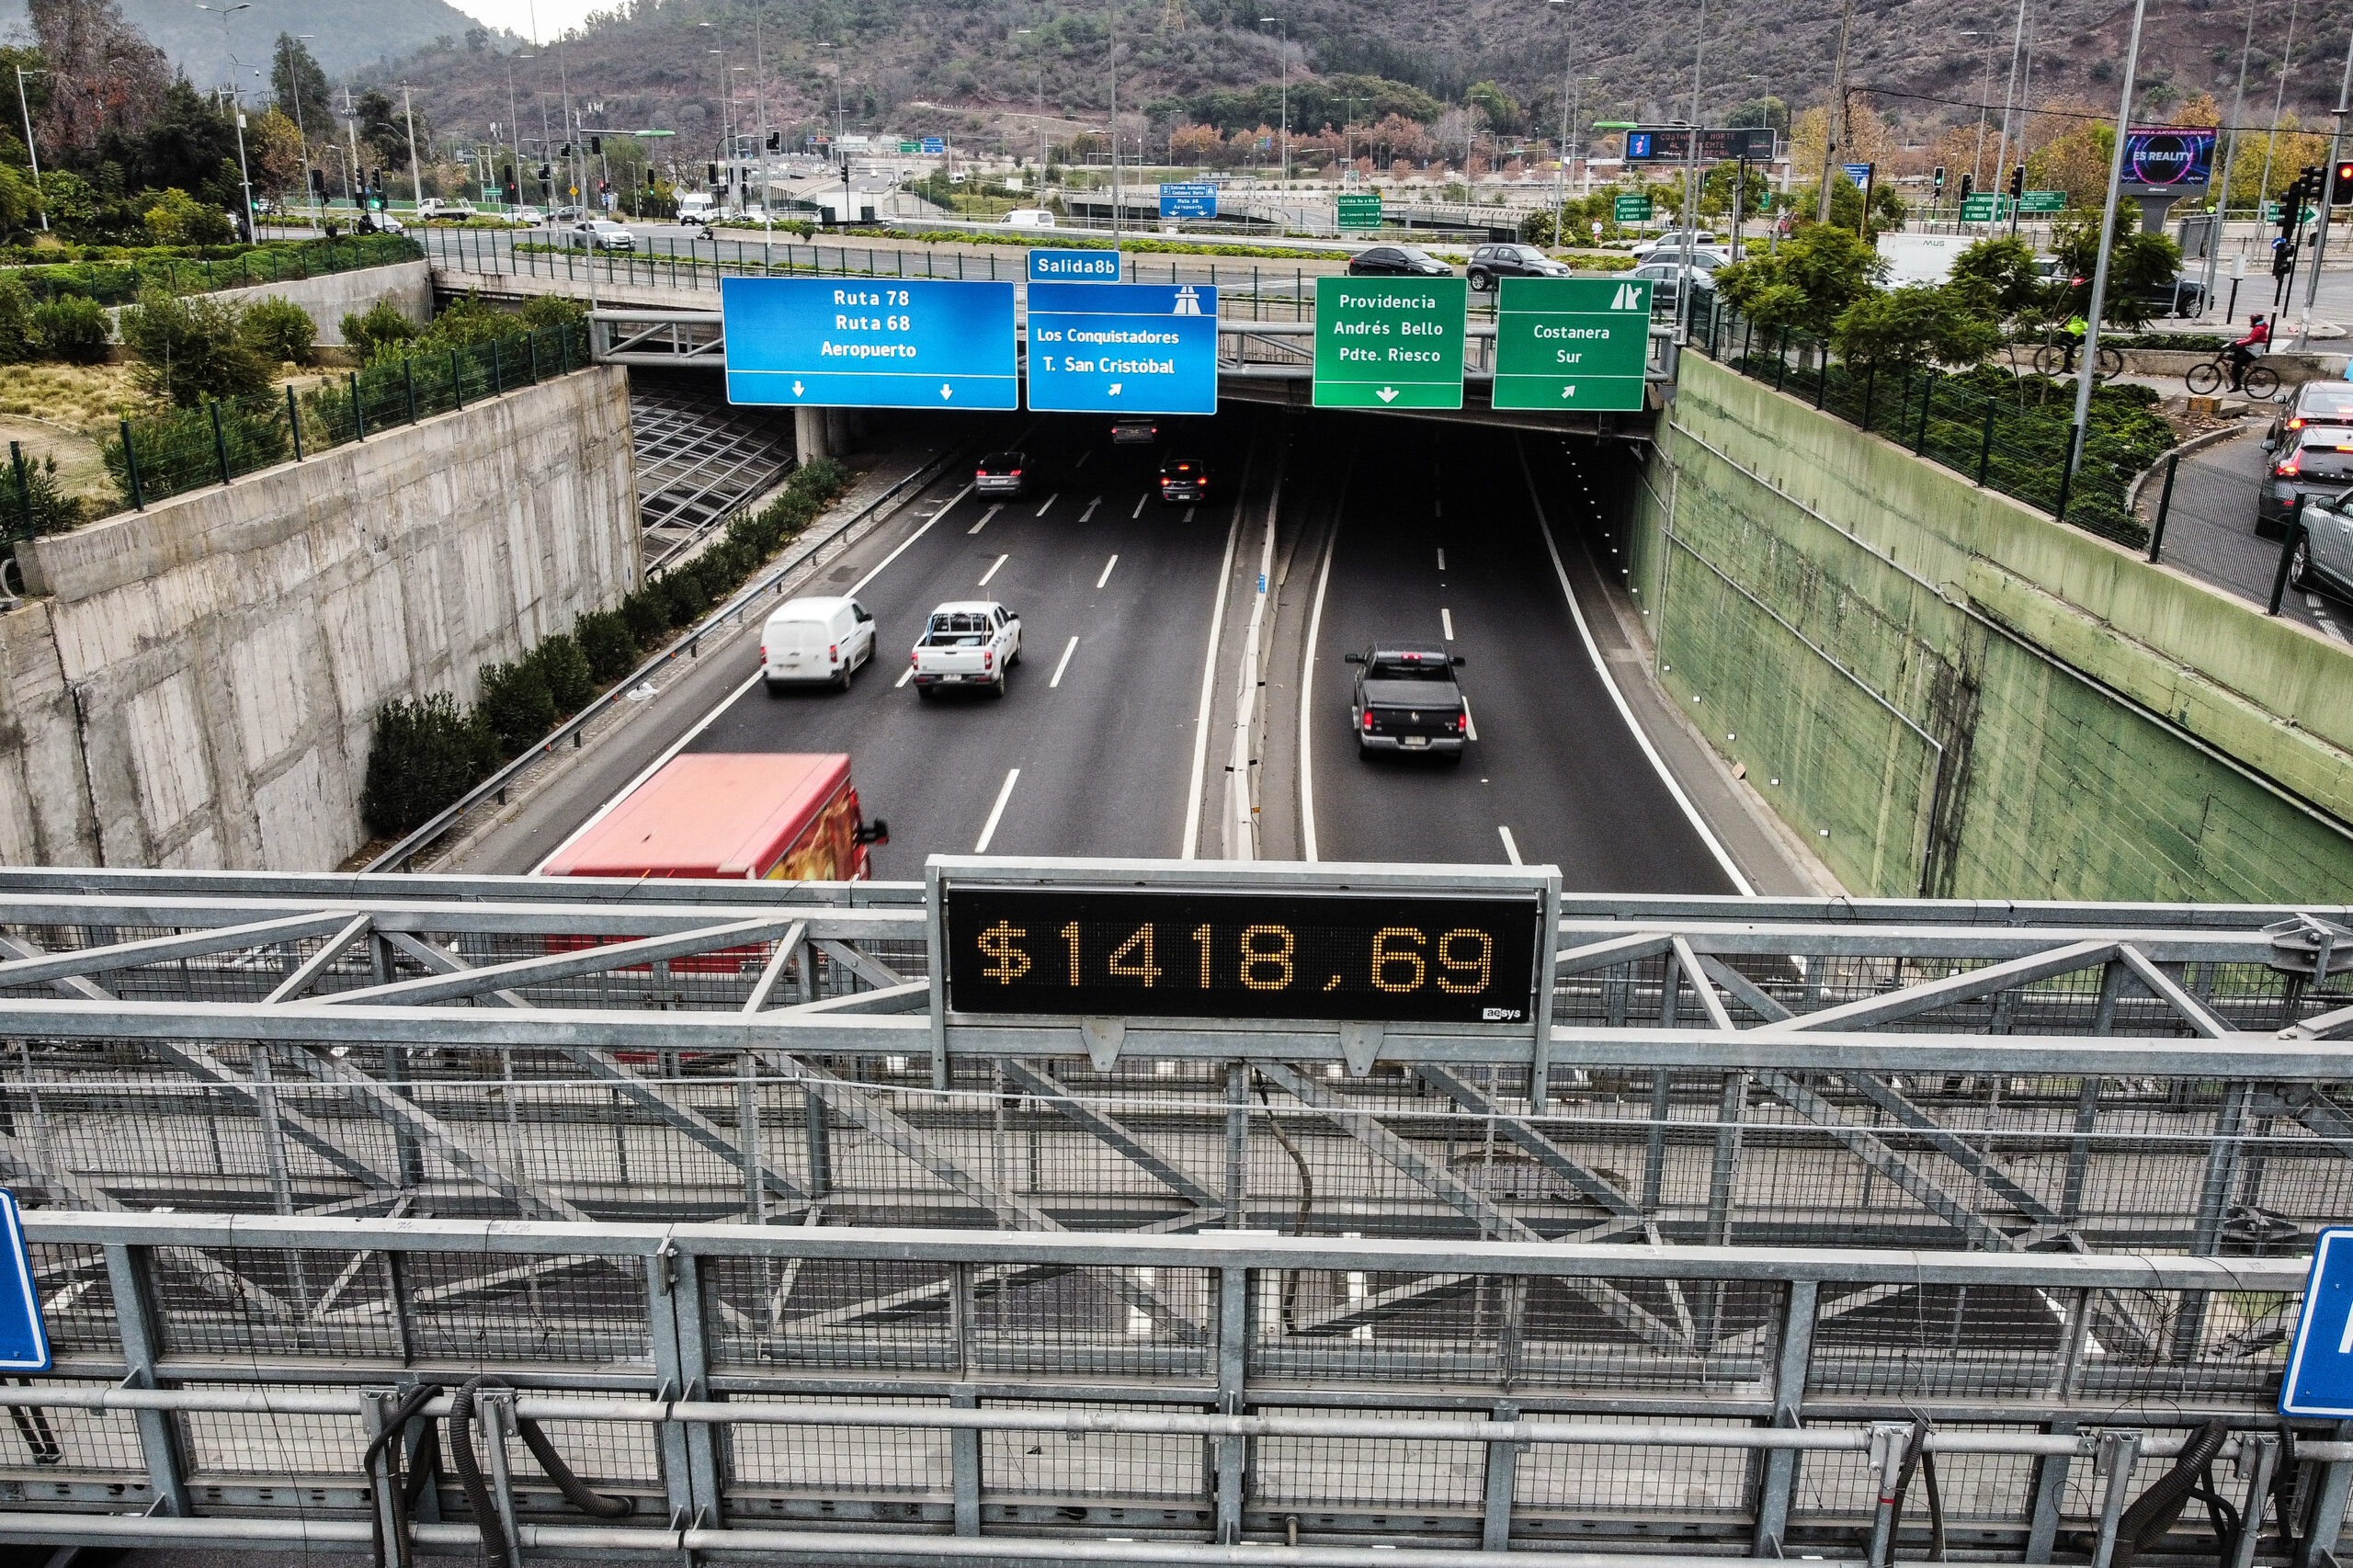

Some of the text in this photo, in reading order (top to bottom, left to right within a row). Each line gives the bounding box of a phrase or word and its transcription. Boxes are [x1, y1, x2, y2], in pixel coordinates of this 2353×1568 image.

[2148, 152, 2191, 161] REALITY
[834, 290, 910, 306] Ruta 78
[1339, 294, 1437, 310] Providencia
[835, 315, 911, 332] Ruta 68
[1334, 320, 1444, 336] Andrés Bello
[1037, 328, 1180, 345] Los Conquistadores
[1533, 324, 1610, 340] Costanera
[821, 341, 917, 359] Aeropuerto
[1339, 347, 1441, 363] Pdte. Riesco
[1556, 349, 1583, 364] Sur
[1042, 356, 1176, 374] T. San Cristóbal
[1484, 1008, 1521, 1020] aesys
